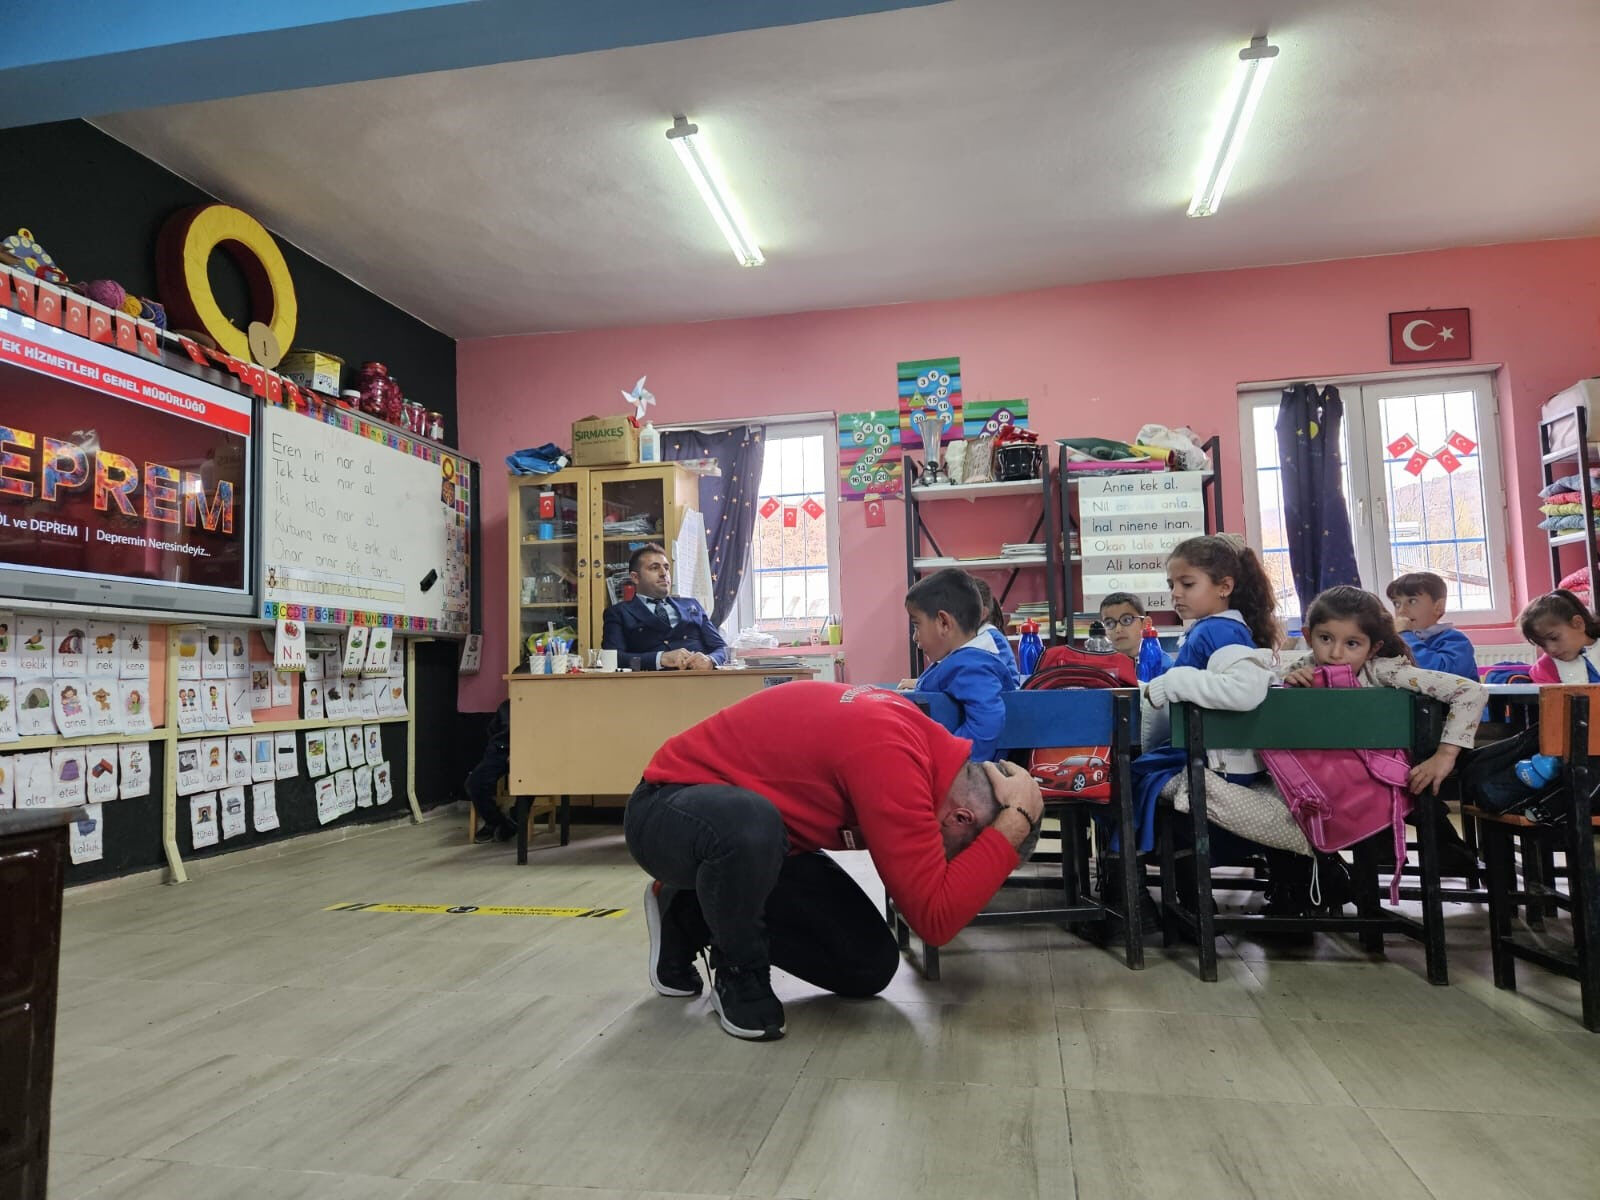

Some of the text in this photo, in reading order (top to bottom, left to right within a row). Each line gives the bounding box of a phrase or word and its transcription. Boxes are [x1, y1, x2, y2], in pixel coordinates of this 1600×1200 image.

[0, 337, 206, 414] EK HİZMETLERİ GENEL MÜDÜRLÜĞÜ
[941, 376, 948, 384] 9
[919, 378, 927, 386] 3
[937, 388, 947, 396] 12
[575, 426, 624, 441] SIRMAKES
[864, 424, 871, 432] 4
[876, 425, 883, 433] 6
[857, 433, 863, 441] 2
[882, 436, 889, 444] 8
[272, 432, 302, 458] Eren
[336, 456, 355, 470] nar
[873, 446, 882, 454] 10
[865, 455, 874, 463] 12
[272, 457, 294, 480] Tek
[337, 478, 355, 490] nar
[857, 464, 866, 472] 14
[851, 475, 860, 483] 16
[863, 474, 872, 482] 18
[877, 473, 887, 481] 20
[1102, 477, 1178, 493] Anne kek al.
[1092, 501, 1109, 512] Nil
[1119, 521, 1158, 532] ninene
[1164, 519, 1193, 530] inan.
[13, 518, 27, 530] ve
[30, 518, 78, 537] DEPREM
[96, 529, 146, 547] Depremin
[149, 539, 211, 557] Neresindeyiz...
[1094, 539, 1126, 552] Okan
[1106, 558, 1162, 571] Ali konak
[1147, 596, 1166, 607] kek
[283, 645, 292, 661] N
[20, 656, 48, 670] keklik
[62, 657, 79, 668] kan
[96, 659, 113, 670] inek
[125, 660, 145, 671] kene
[32, 717, 40, 727] in
[64, 718, 87, 729] anne
[59, 784, 80, 799] etek
[25, 794, 46, 807] olta
